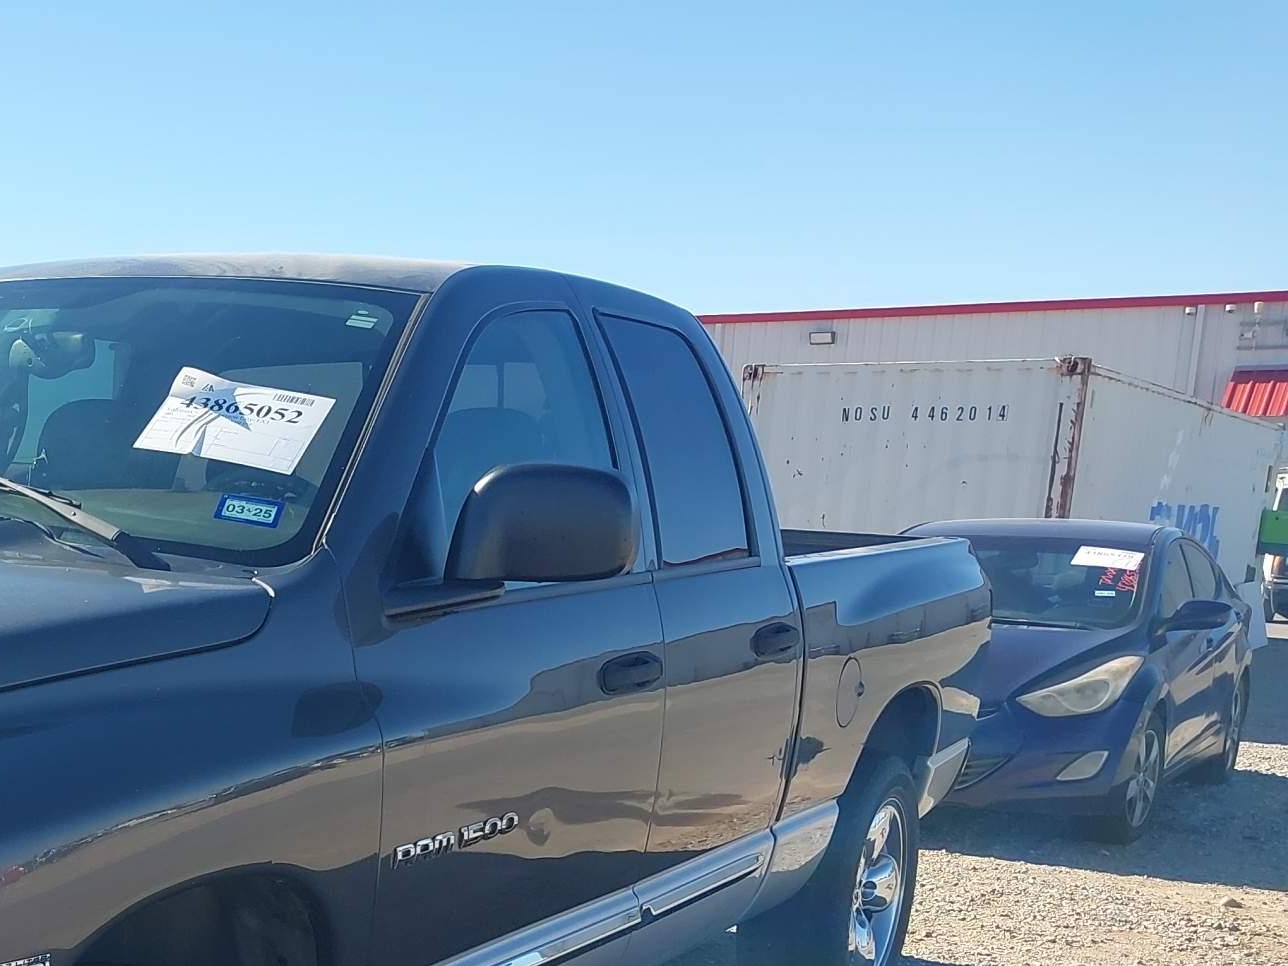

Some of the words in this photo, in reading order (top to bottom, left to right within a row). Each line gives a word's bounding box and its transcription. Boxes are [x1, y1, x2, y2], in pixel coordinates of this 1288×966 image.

[181, 396, 303, 424] 43865052
[841, 406, 891, 422] NOSU
[911, 405, 1009, 422] 4462014
[458, 811, 519, 849] 1500
